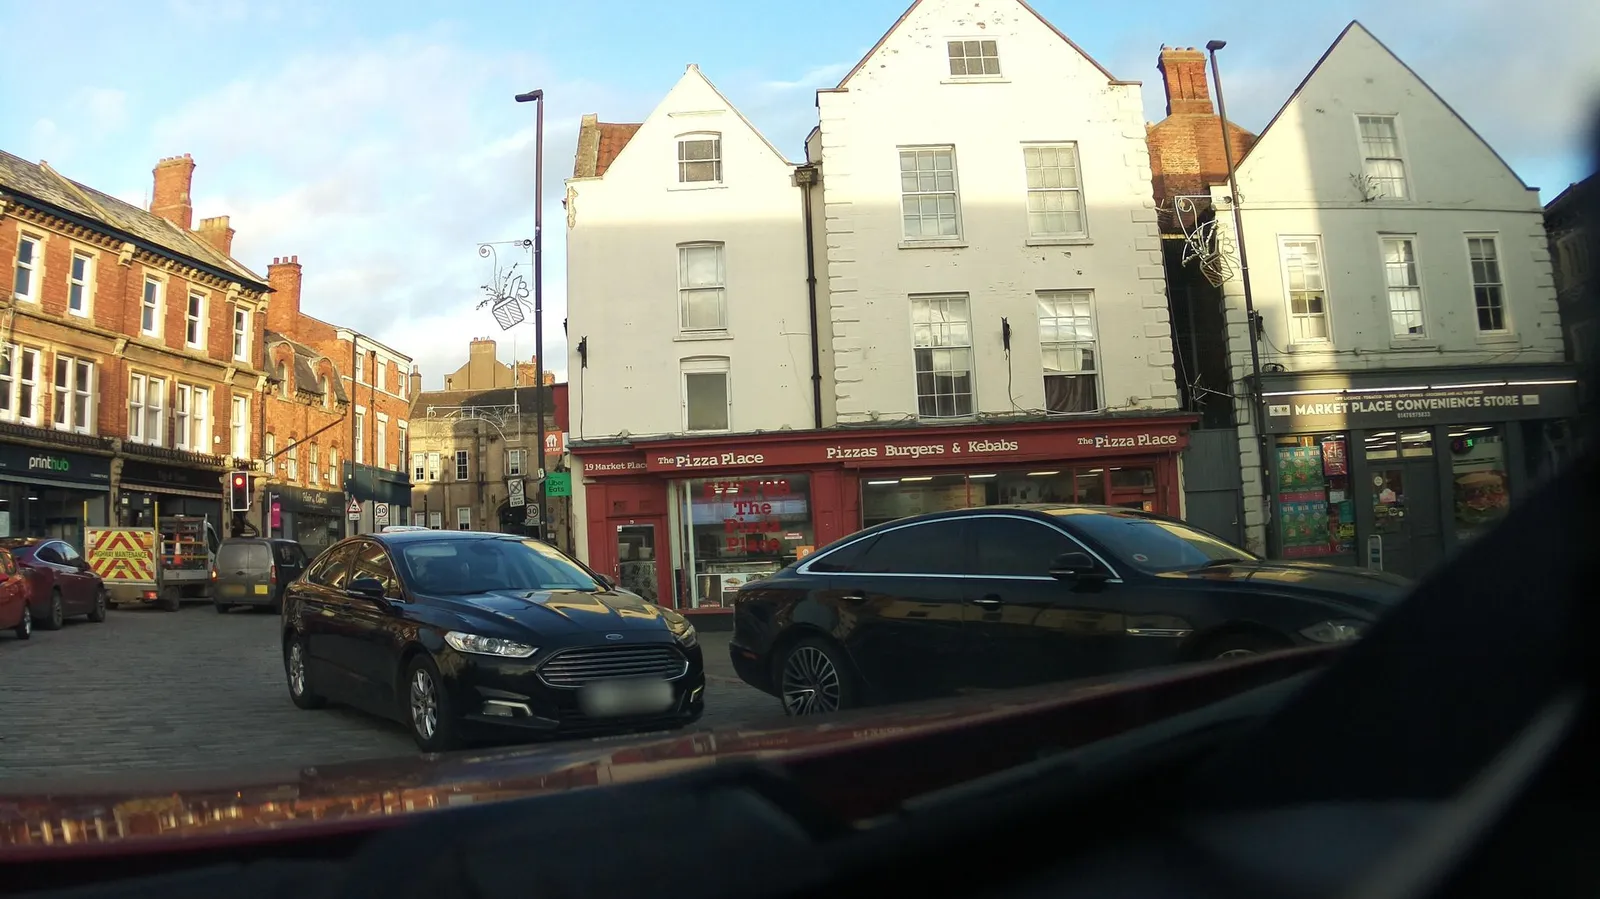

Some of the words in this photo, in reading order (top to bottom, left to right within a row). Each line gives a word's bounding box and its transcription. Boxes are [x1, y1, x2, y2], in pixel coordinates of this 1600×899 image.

[1295, 403, 1348, 415] MARKET
[1352, 400, 1392, 413] PLACE
[1395, 396, 1481, 410] CONVENIENCE
[1484, 395, 1519, 407] STORE
[1095, 435, 1135, 447] Pizza
[1137, 434, 1176, 446] Place
[827, 446, 877, 458] Pizzas
[885, 444, 944, 458] Burgers
[952, 442, 961, 453] &
[968, 440, 1018, 452] Kebabs
[29, 454, 69, 471] printhub
[676, 455, 718, 467] Pizza
[721, 453, 764, 464] Place
[734, 501, 772, 515] The
